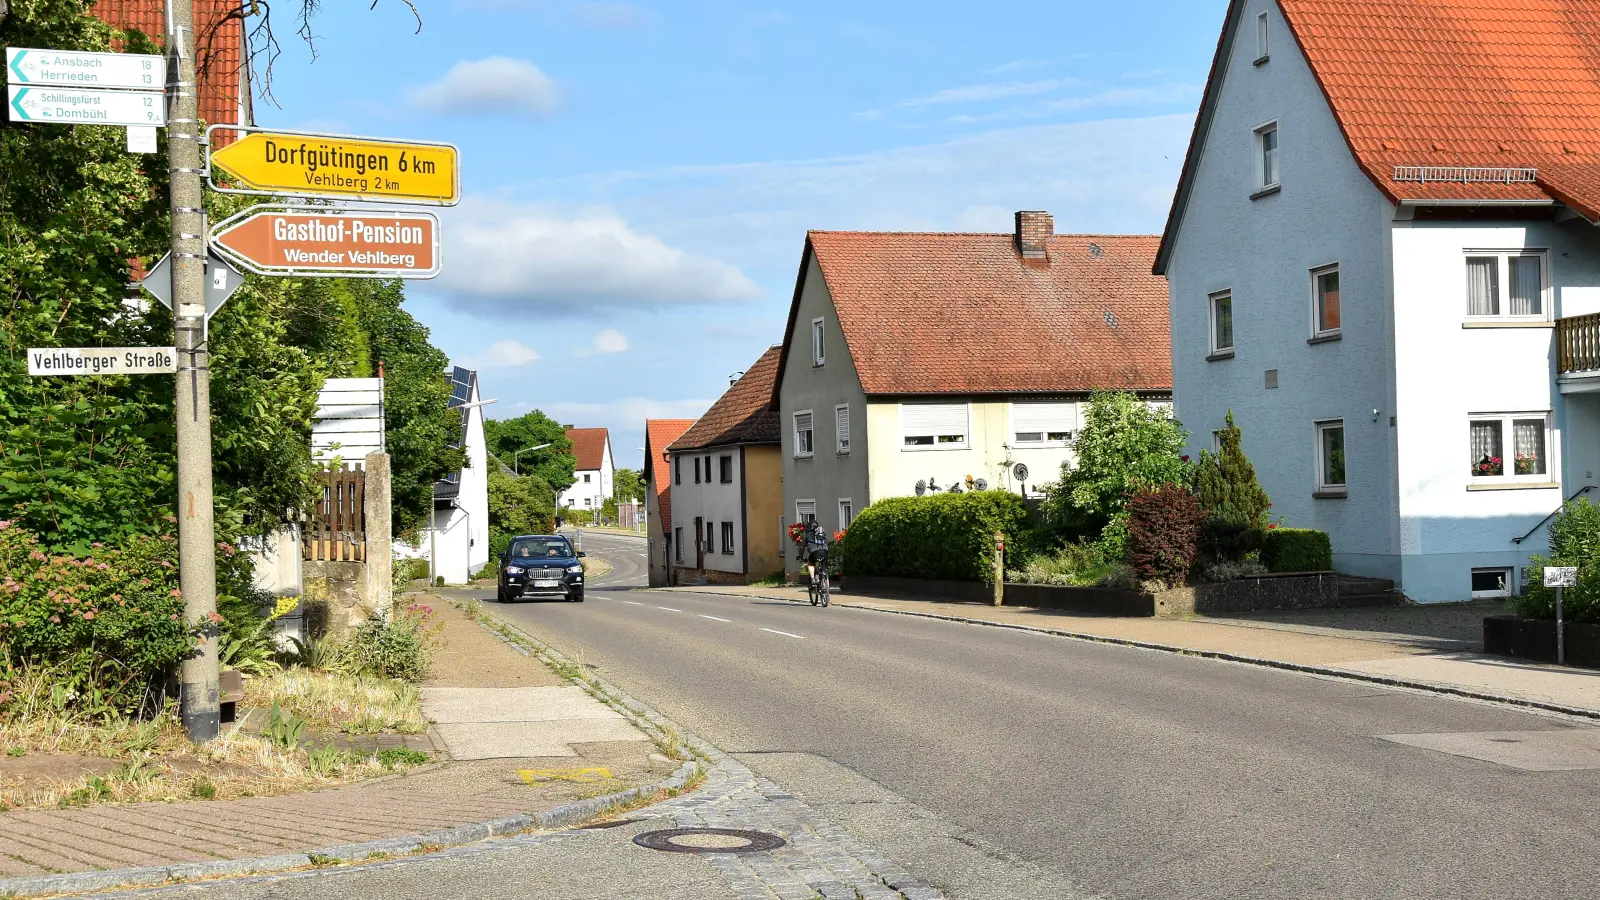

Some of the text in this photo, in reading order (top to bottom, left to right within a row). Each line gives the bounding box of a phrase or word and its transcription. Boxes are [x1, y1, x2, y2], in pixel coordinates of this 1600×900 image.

[54, 55, 152, 70] Ansbach 18
[41, 70, 152, 84] Herrieden 13
[41, 93, 153, 107] Schillingsfürst 12
[56, 107, 107, 119] Dombühl
[265, 140, 435, 174] Dorfgütingen 6 km
[305, 172, 400, 191] Vehlberg 2 km
[274, 217, 423, 244] Gasthof-Pension
[284, 249, 415, 267] Wender Vehlberg
[34, 351, 171, 373] Vehlberger Straße
